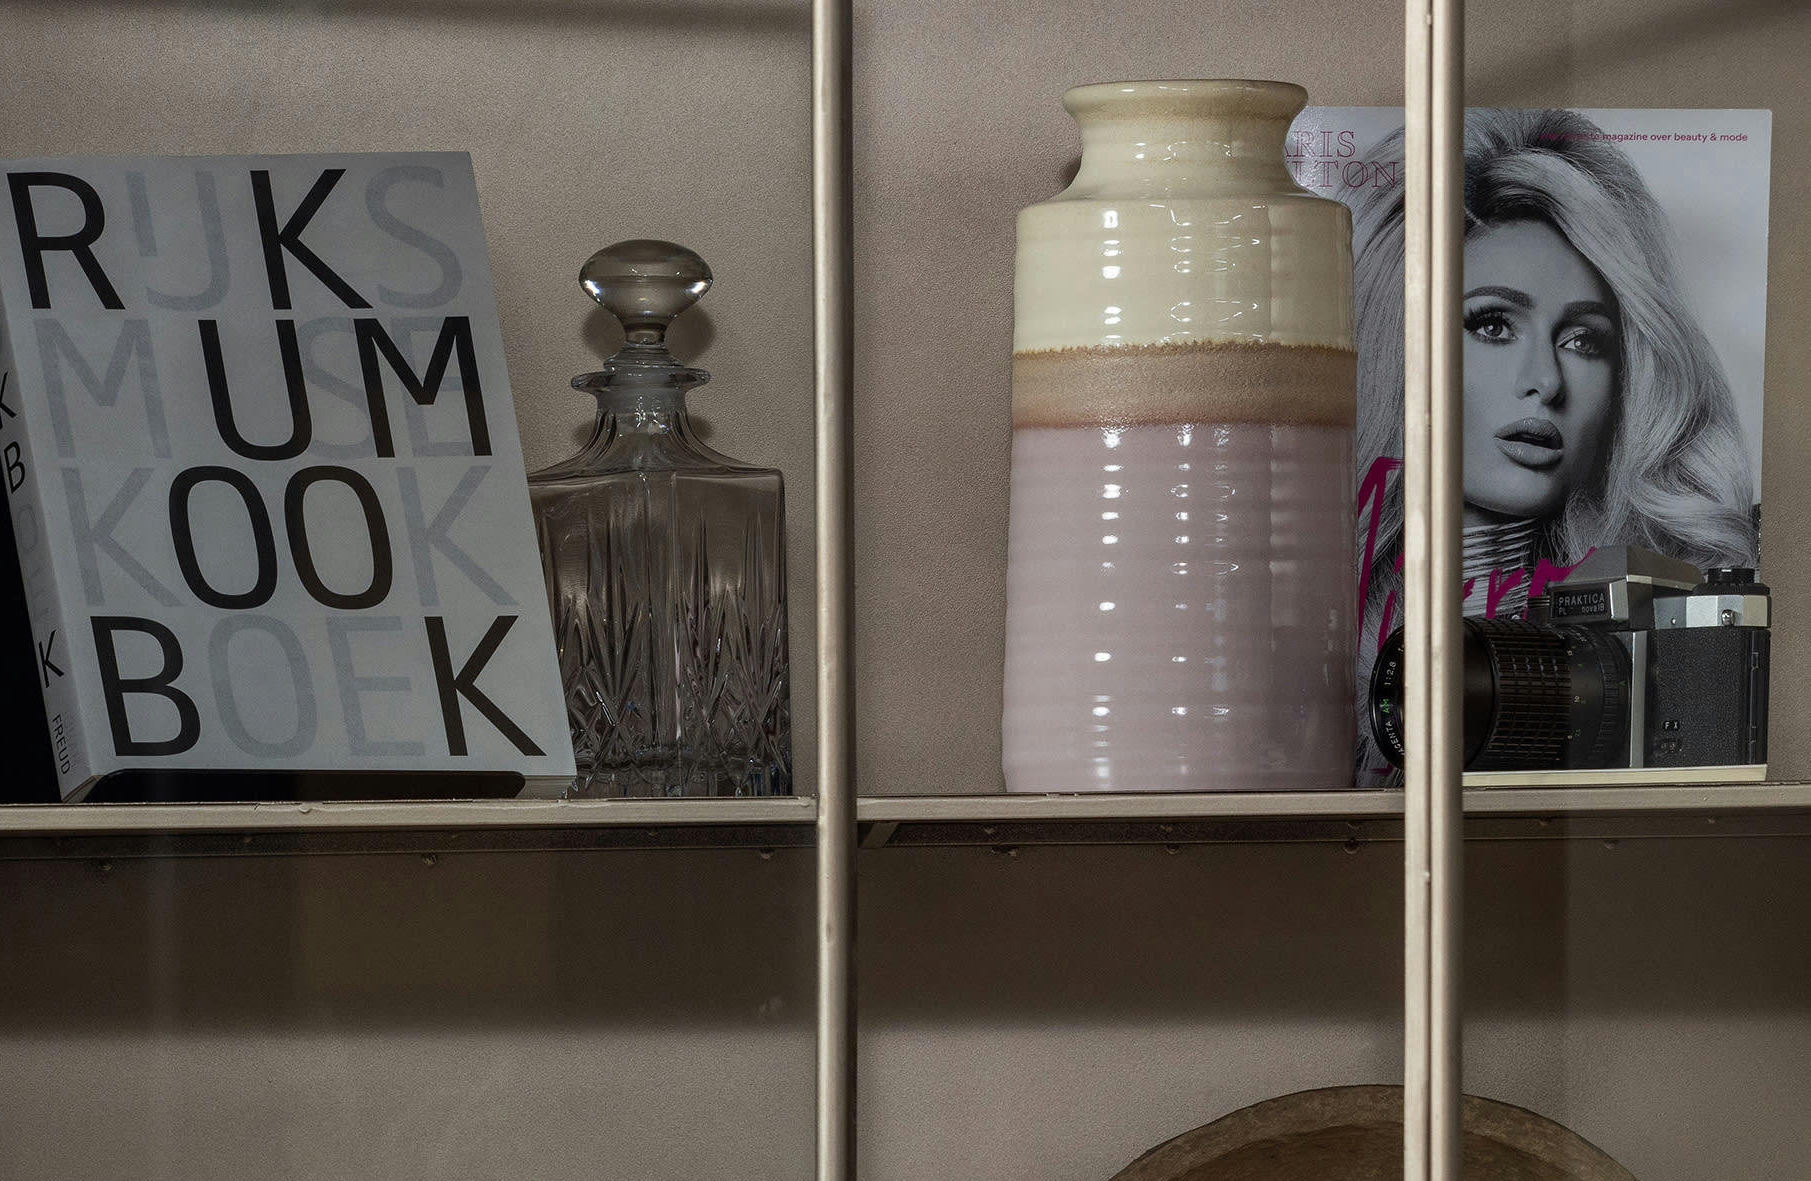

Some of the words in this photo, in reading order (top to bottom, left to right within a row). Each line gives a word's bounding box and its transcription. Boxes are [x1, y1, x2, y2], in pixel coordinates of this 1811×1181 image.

[1603, 133, 1648, 143] magazine
[1674, 133, 1707, 143] beauty
[1710, 133, 1717, 141] &
[1720, 133, 1748, 141] mode
[1558, 592, 1605, 607] PRAKTICA
[51, 712, 72, 776] FREUD
